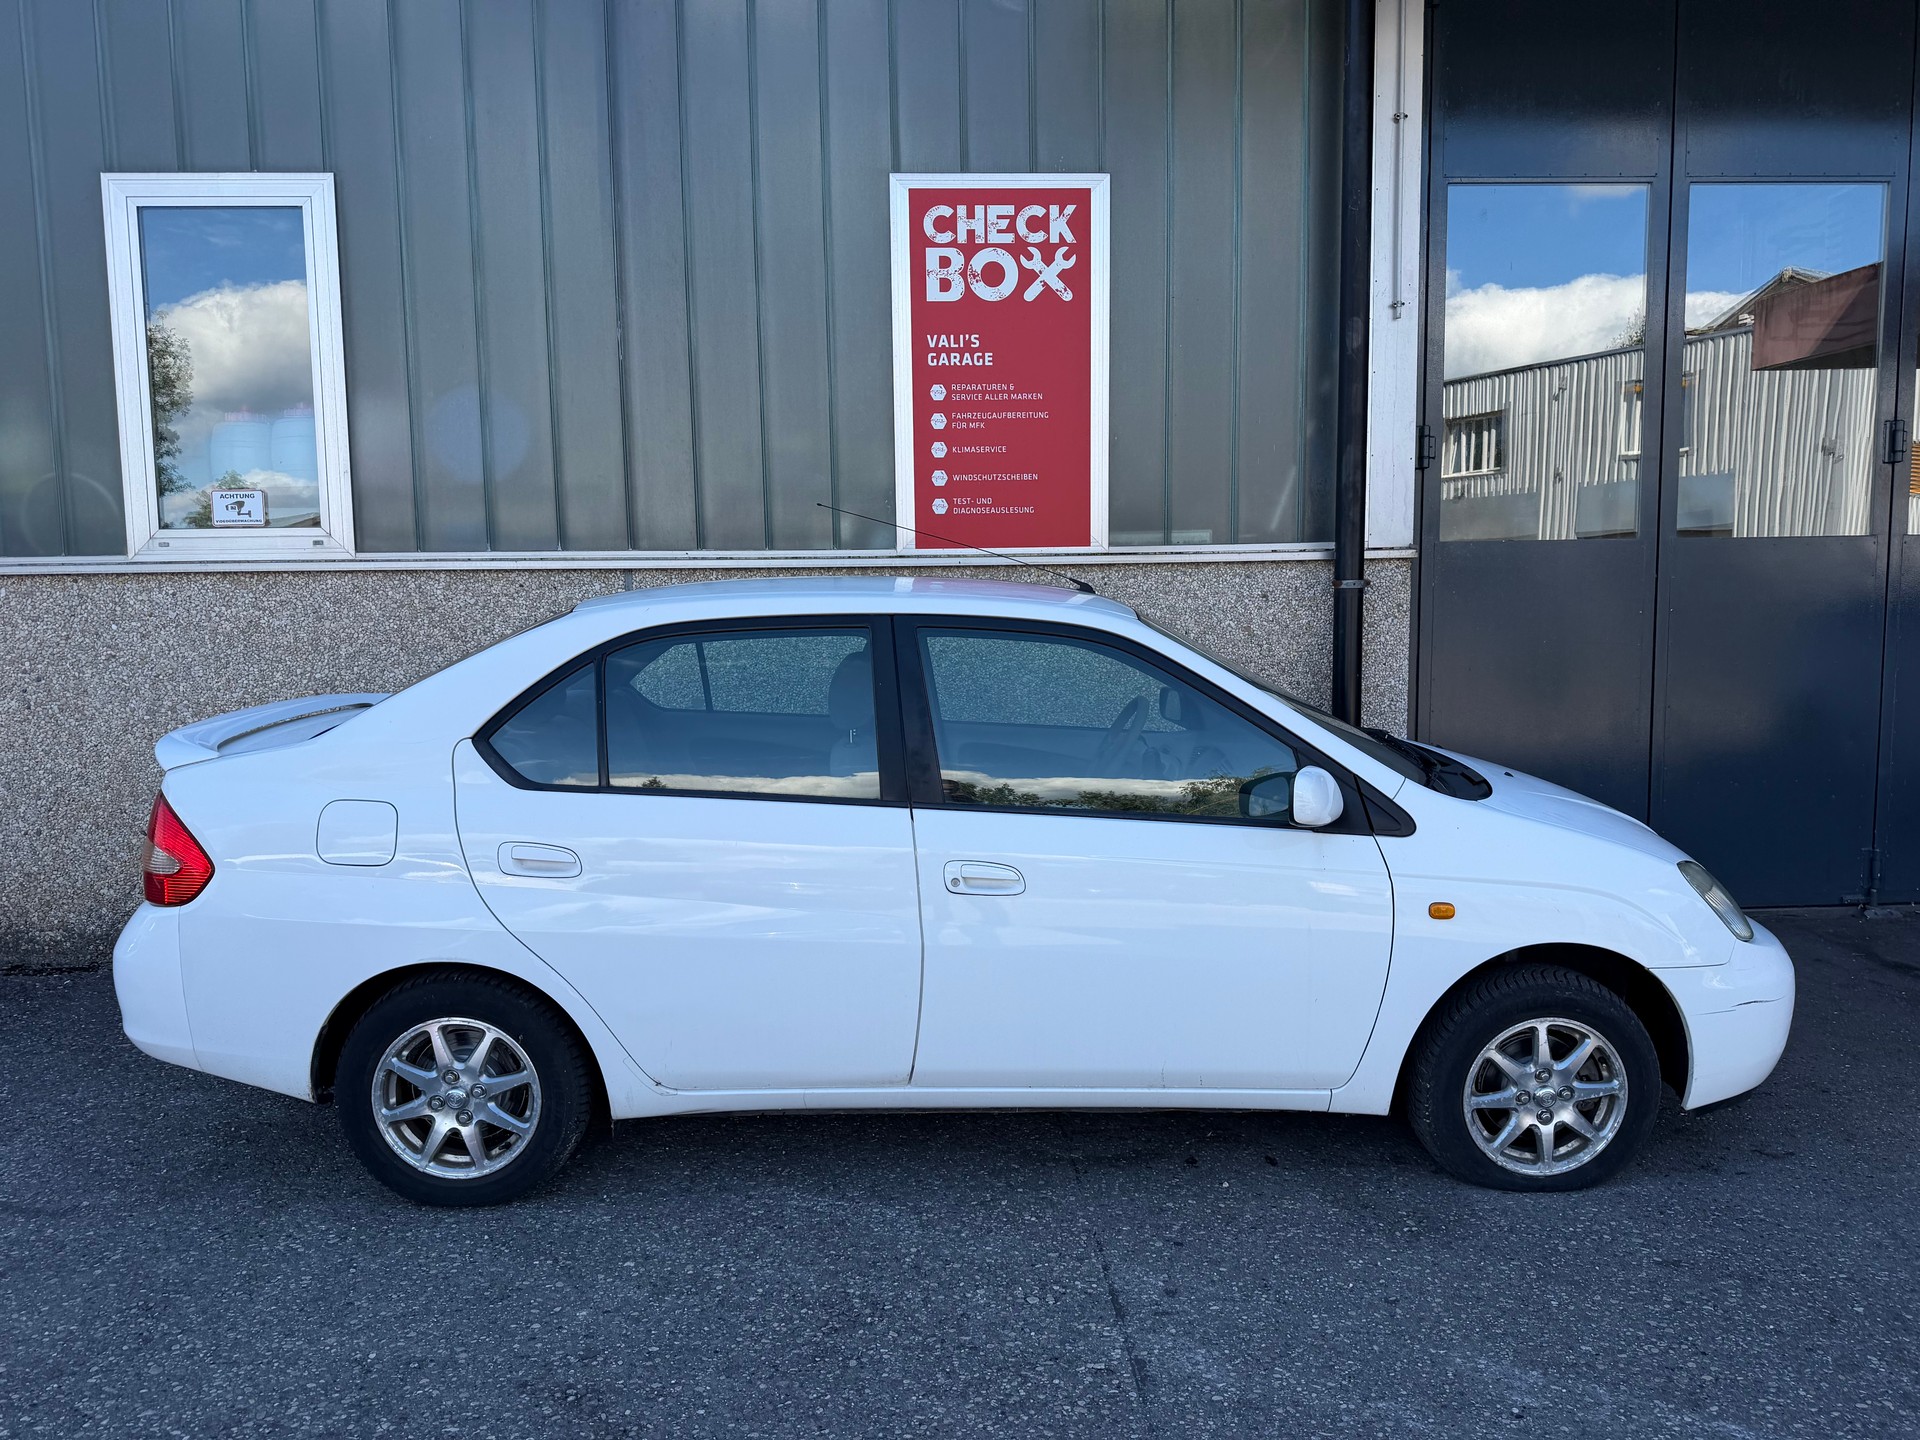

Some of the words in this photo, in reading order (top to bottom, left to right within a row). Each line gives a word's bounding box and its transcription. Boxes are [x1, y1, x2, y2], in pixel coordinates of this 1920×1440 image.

[923, 205, 1077, 244] CHECK
[926, 246, 1077, 302] BOX
[926, 334, 980, 348] VALI'S
[927, 352, 993, 366] GARAGE
[951, 383, 1008, 391] REPARATUREN
[1009, 383, 1015, 391] &
[1010, 392, 1043, 400] MARKEN
[951, 411, 1049, 419] FAHRZEUGAUFBEREITUNG
[951, 421, 967, 429] FÜR
[952, 445, 1007, 453] KLIMASERVICE
[952, 473, 1038, 481] WINDSCHUTZSCHEIBEN
[953, 497, 975, 505] TEST-
[976, 497, 993, 505] UND
[953, 506, 1035, 515] DIAGNOSEAUSLESUNG
